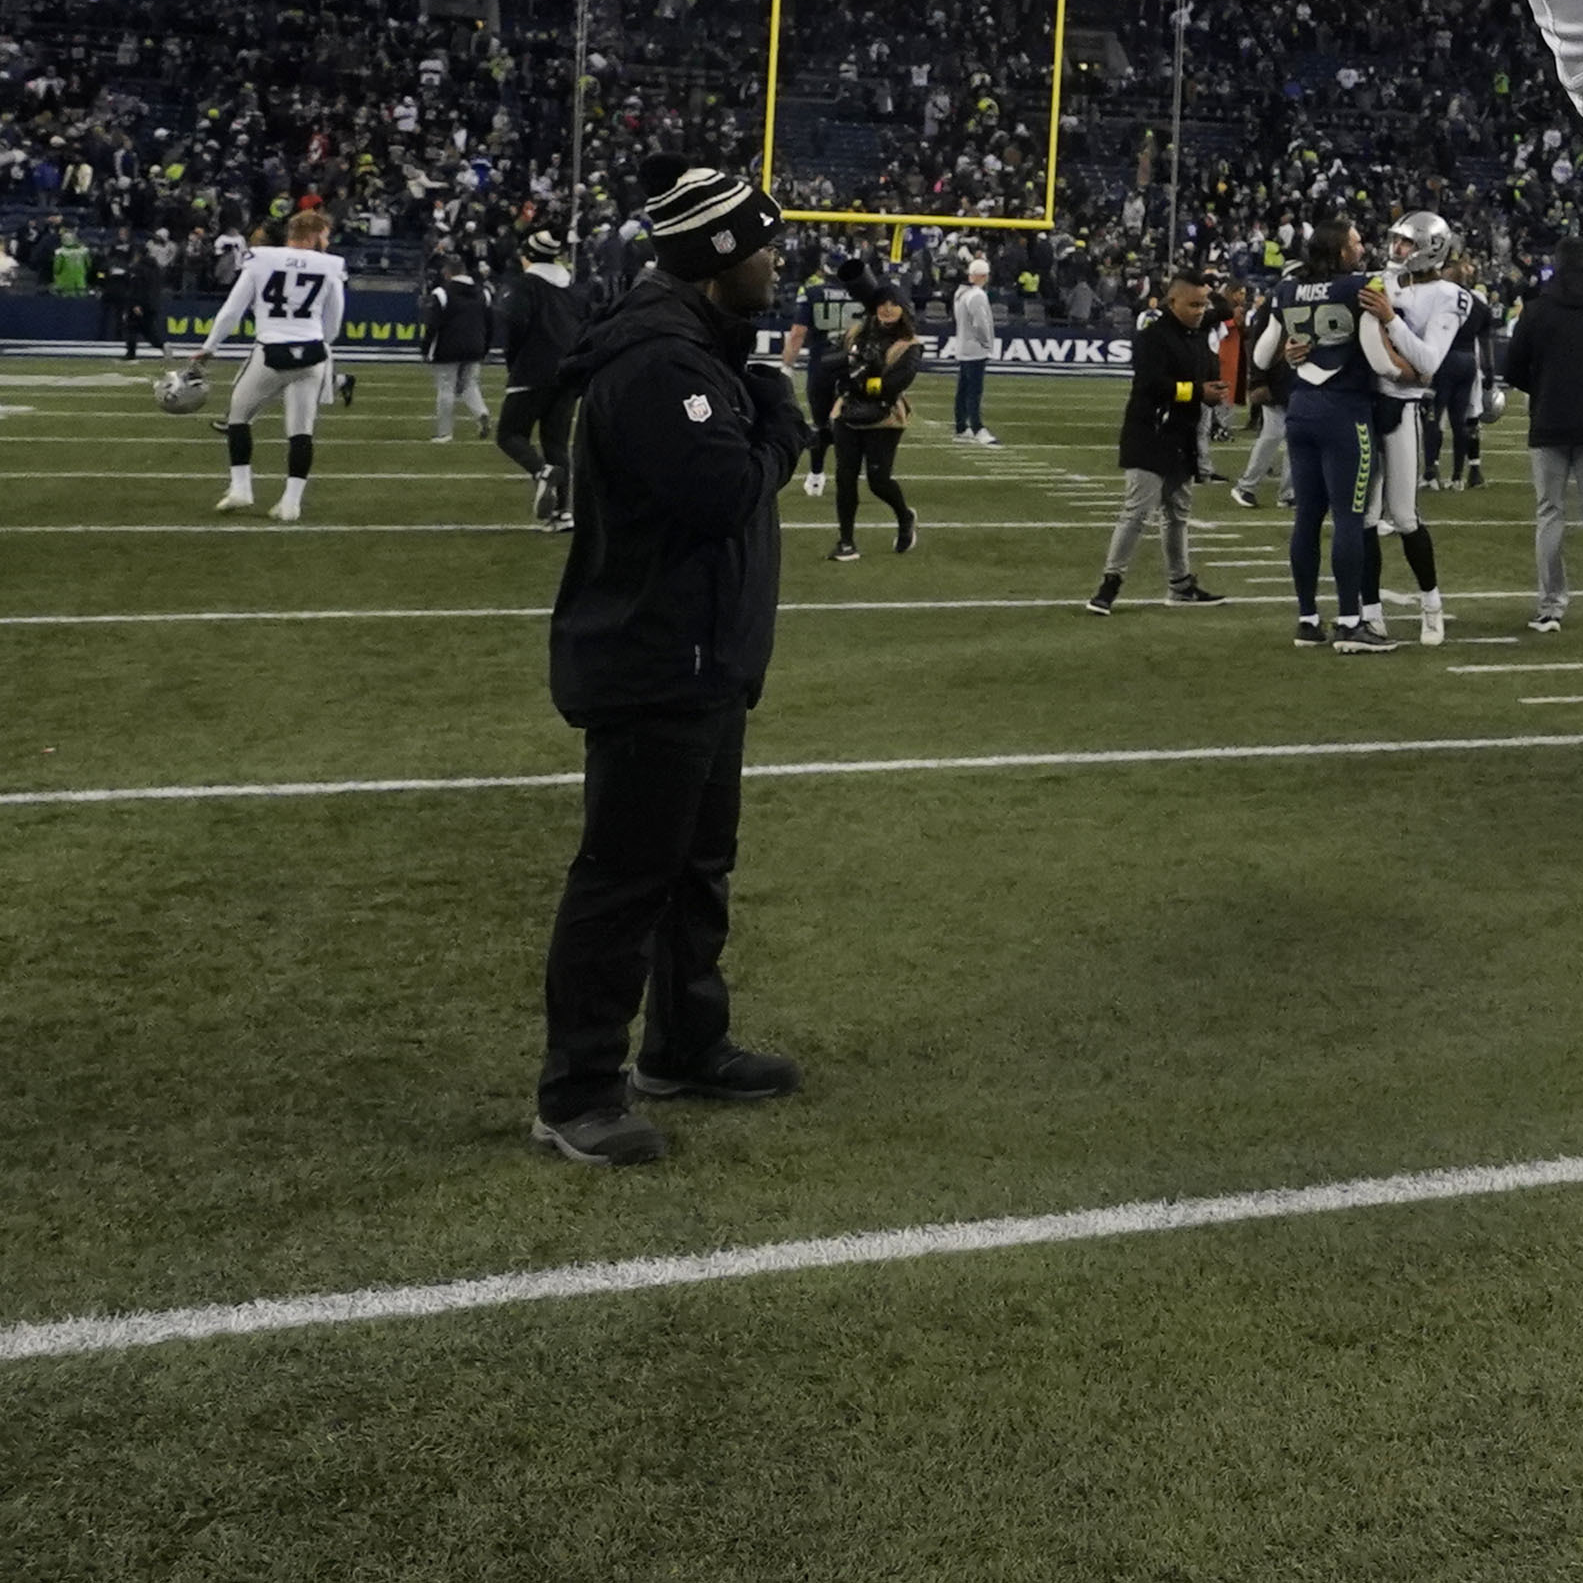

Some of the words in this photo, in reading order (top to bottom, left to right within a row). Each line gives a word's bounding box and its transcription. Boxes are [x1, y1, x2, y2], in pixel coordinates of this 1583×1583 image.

[262, 270, 325, 319] 47
[1295, 282, 1333, 302] MUSE
[1282, 304, 1354, 346] 58
[922, 335, 1133, 362] EAAWKS
